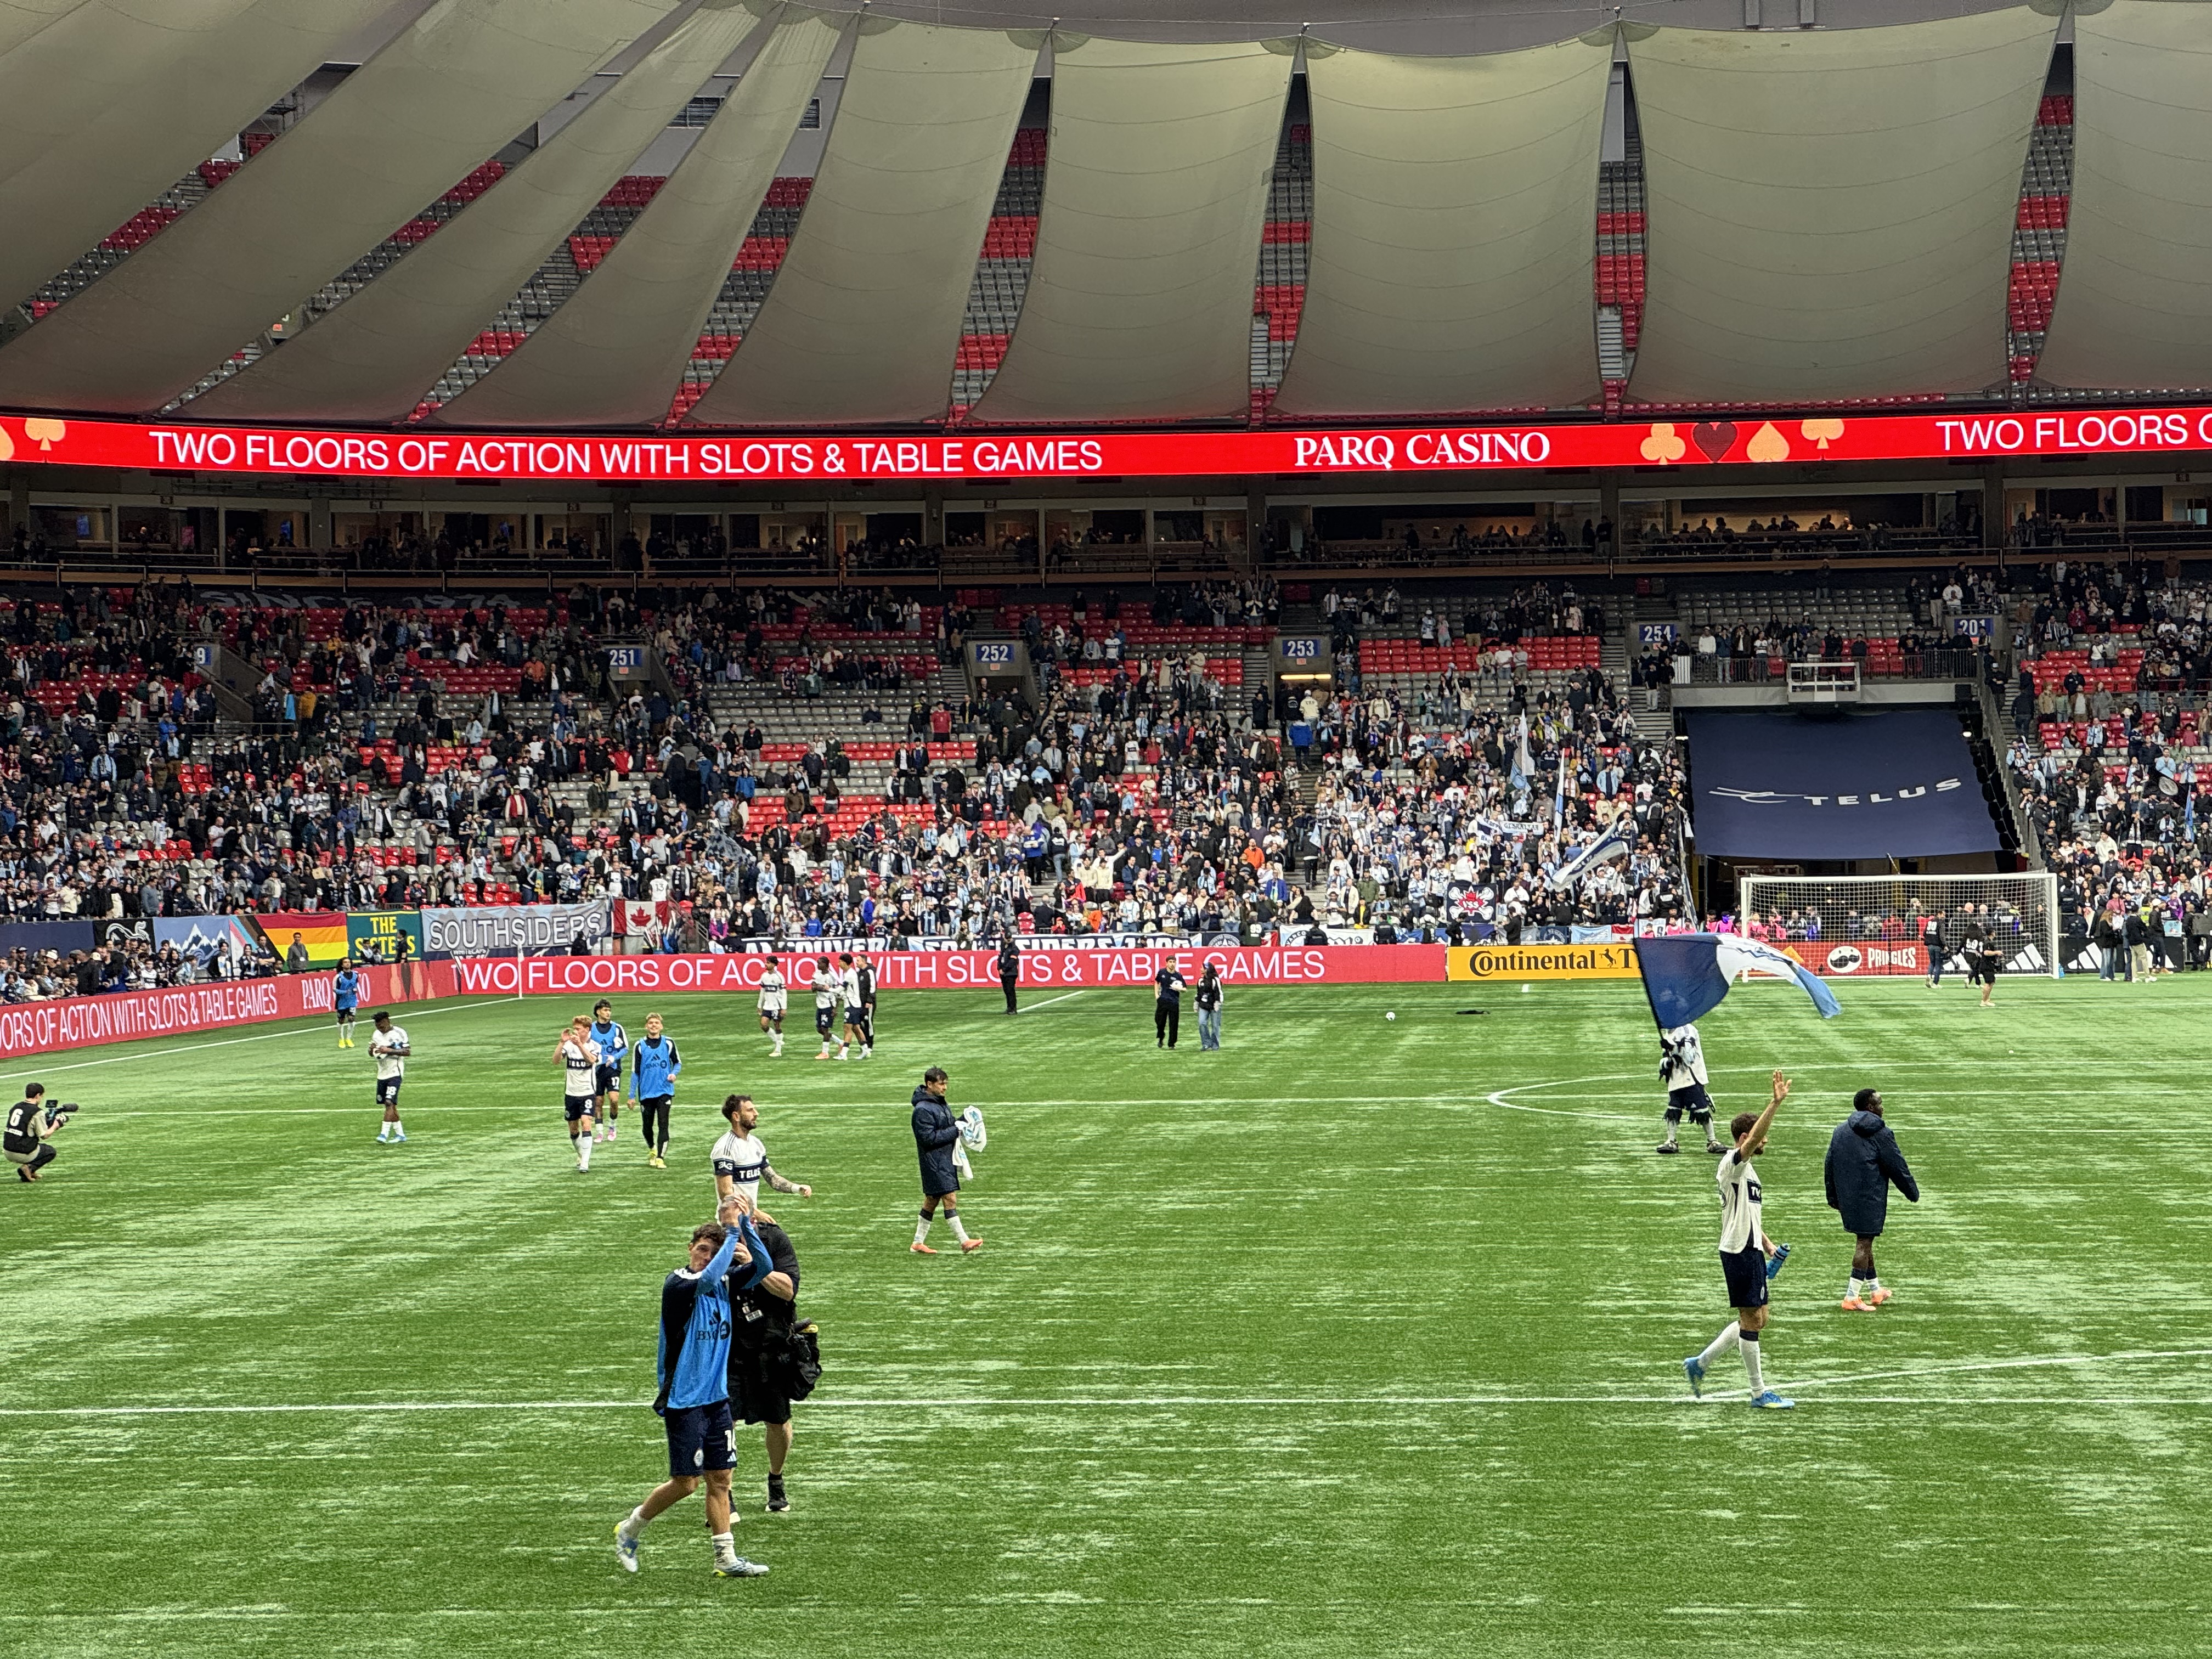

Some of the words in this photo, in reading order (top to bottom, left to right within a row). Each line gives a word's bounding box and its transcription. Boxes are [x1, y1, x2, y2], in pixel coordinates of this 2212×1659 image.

[1936, 419, 2024, 450] TWO
[2036, 414, 2188, 448] FLOORS
[149, 431, 235, 465] TWO
[246, 435, 389, 470] FLOORS
[398, 441, 449, 471] OF
[455, 442, 590, 473] ACTION
[599, 444, 689, 473] WITH
[699, 443, 814, 473] SLOTS
[823, 443, 846, 473] &
[853, 443, 964, 472] TABLE
[973, 441, 1102, 471] GAMES
[1294, 435, 1394, 470] PARQ
[1406, 432, 1550, 464] CASINO
[1644, 625, 1672, 642] 254
[610, 650, 634, 665] 251
[981, 645, 1008, 661] 252
[1287, 640, 1314, 657] 253
[1803, 778, 1962, 806] TELUS
[655, 883, 663, 892] 13
[370, 916, 398, 934] THE
[430, 912, 601, 950] SOUTHSIDERS
[1470, 950, 1596, 976] Continental
[1868, 947, 1916, 969] PRINGLES
[528, 959, 660, 989] FLOORS
[668, 958, 714, 987] OF
[1061, 954, 1083, 982] &
[301, 977, 331, 1012] PARQ
[36, 1008, 57, 1045] OF
[60, 1002, 111, 1042] ACTION
[111, 997, 146, 1035] WITH
[149, 993, 188, 1031] SLOTS
[189, 992, 200, 1025] &
[198, 988, 236, 1024] TABLE
[236, 984, 278, 1018] GAMES
[584, 1099, 592, 1109] 8
[10, 1109, 24, 1127] 6
[739, 1167, 760, 1180] TELUS
